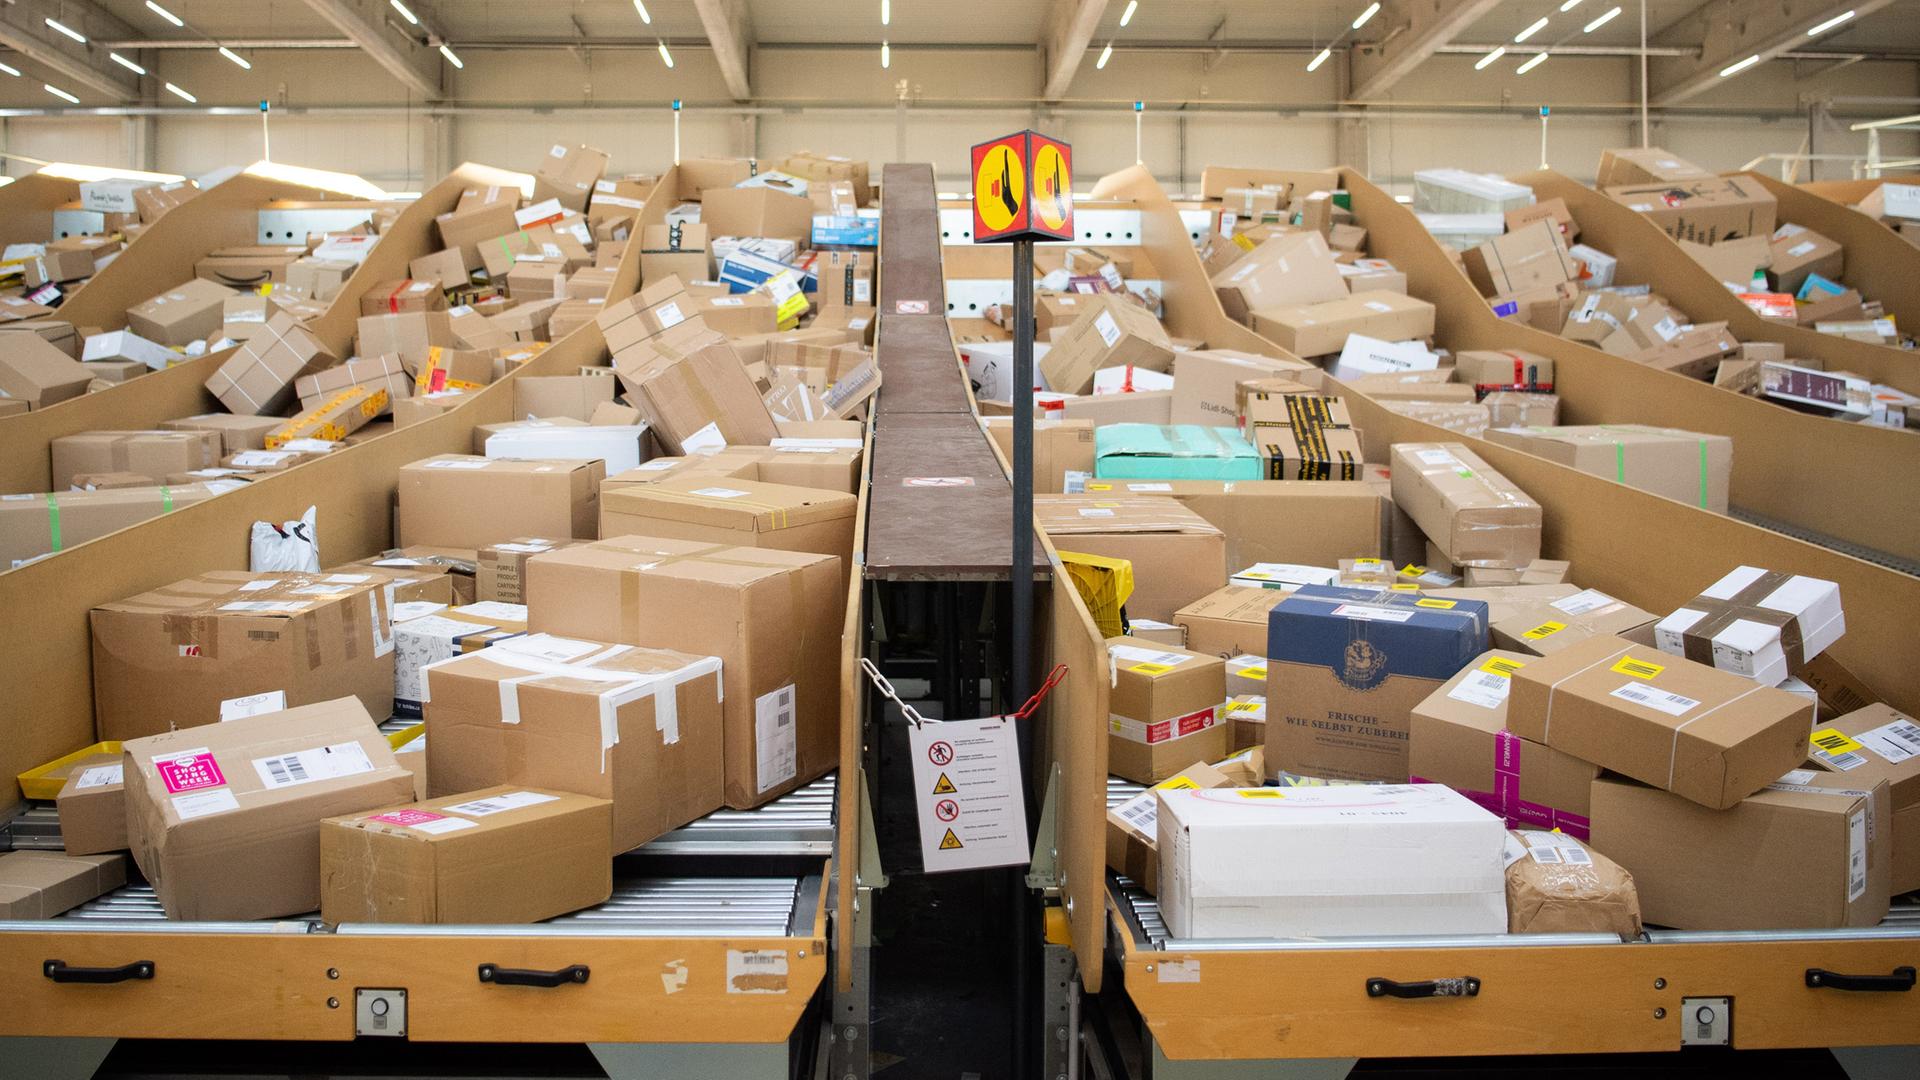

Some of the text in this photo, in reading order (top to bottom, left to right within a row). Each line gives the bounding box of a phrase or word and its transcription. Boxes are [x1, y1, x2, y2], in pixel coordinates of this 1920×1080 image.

[1328, 711, 1378, 725] FRISCHE
[1286, 716, 1309, 728] WIE
[1311, 720, 1354, 733] SELBST
[173, 765, 205, 776] SHOP
[176, 770, 208, 781] PING
[178, 776, 211, 786] WEEK
